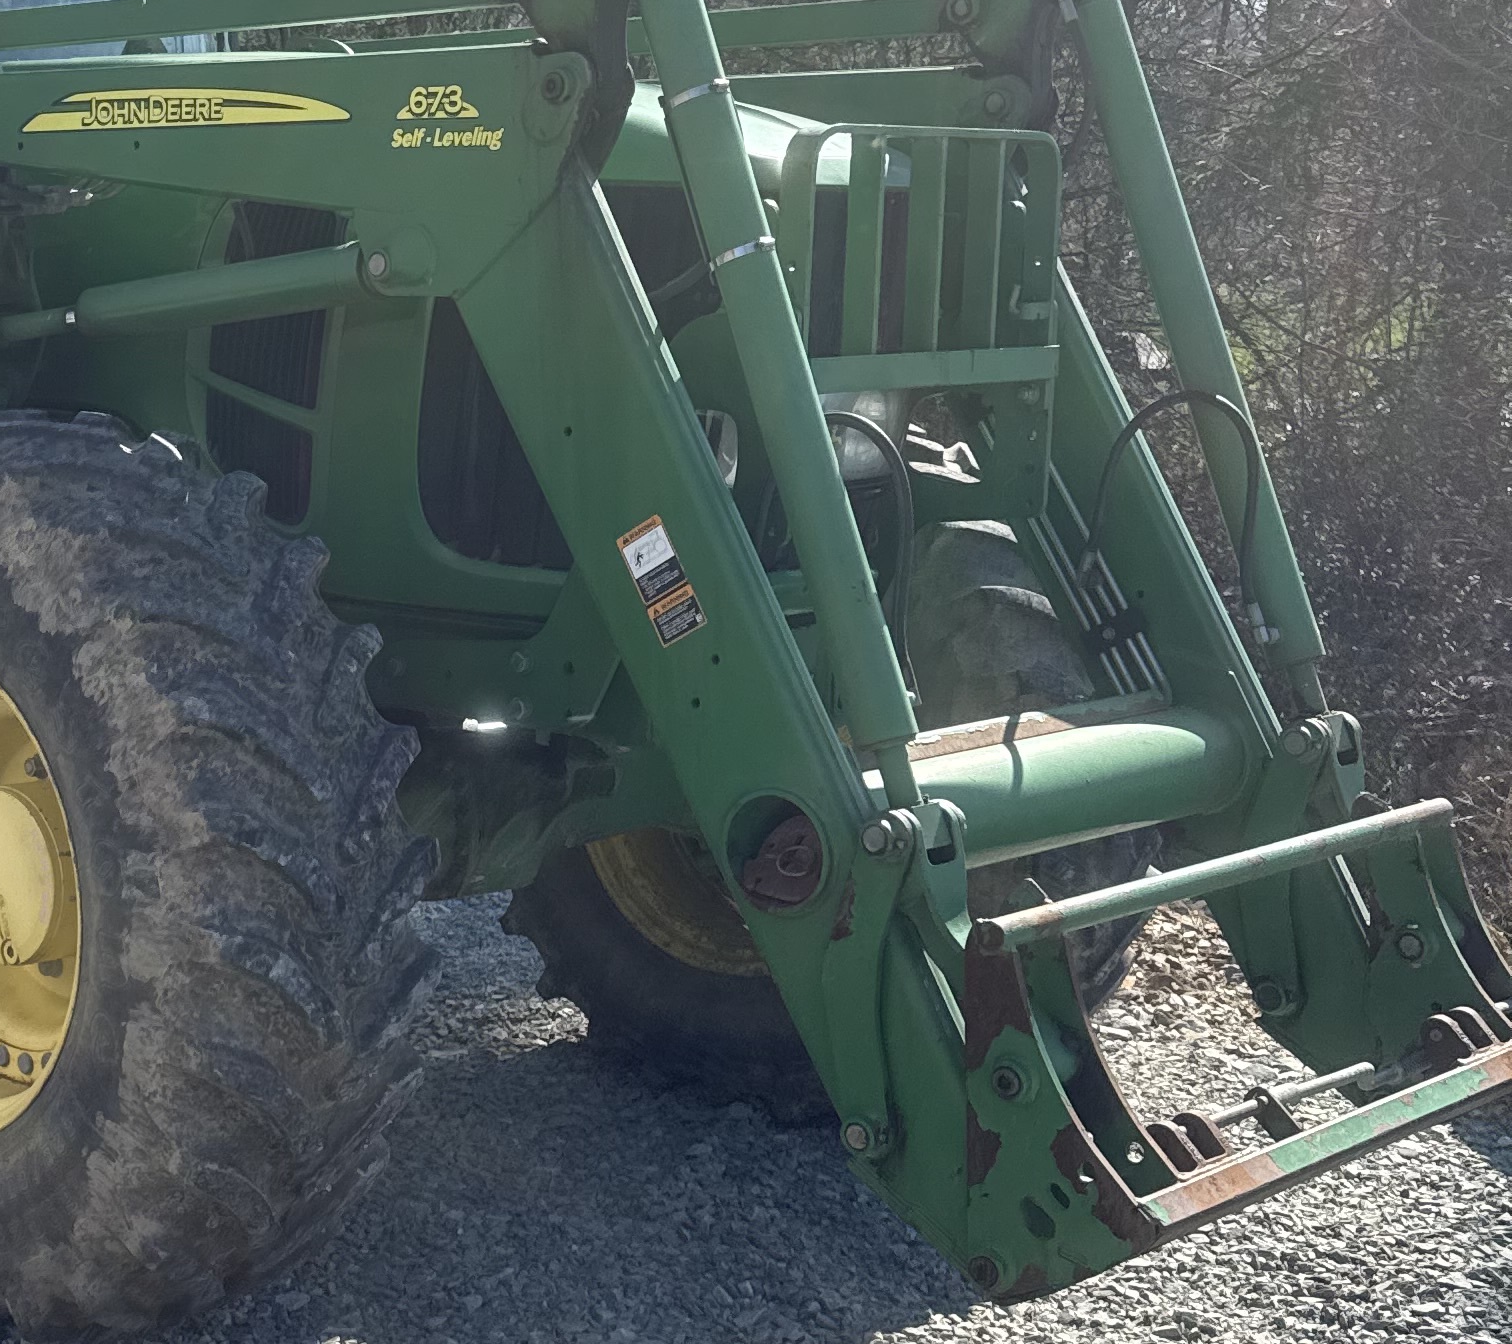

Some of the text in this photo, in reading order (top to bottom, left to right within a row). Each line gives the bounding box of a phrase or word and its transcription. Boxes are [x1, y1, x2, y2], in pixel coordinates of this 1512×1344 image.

[82, 94, 225, 126] JOHN DEERE
[409, 84, 464, 117] 673
